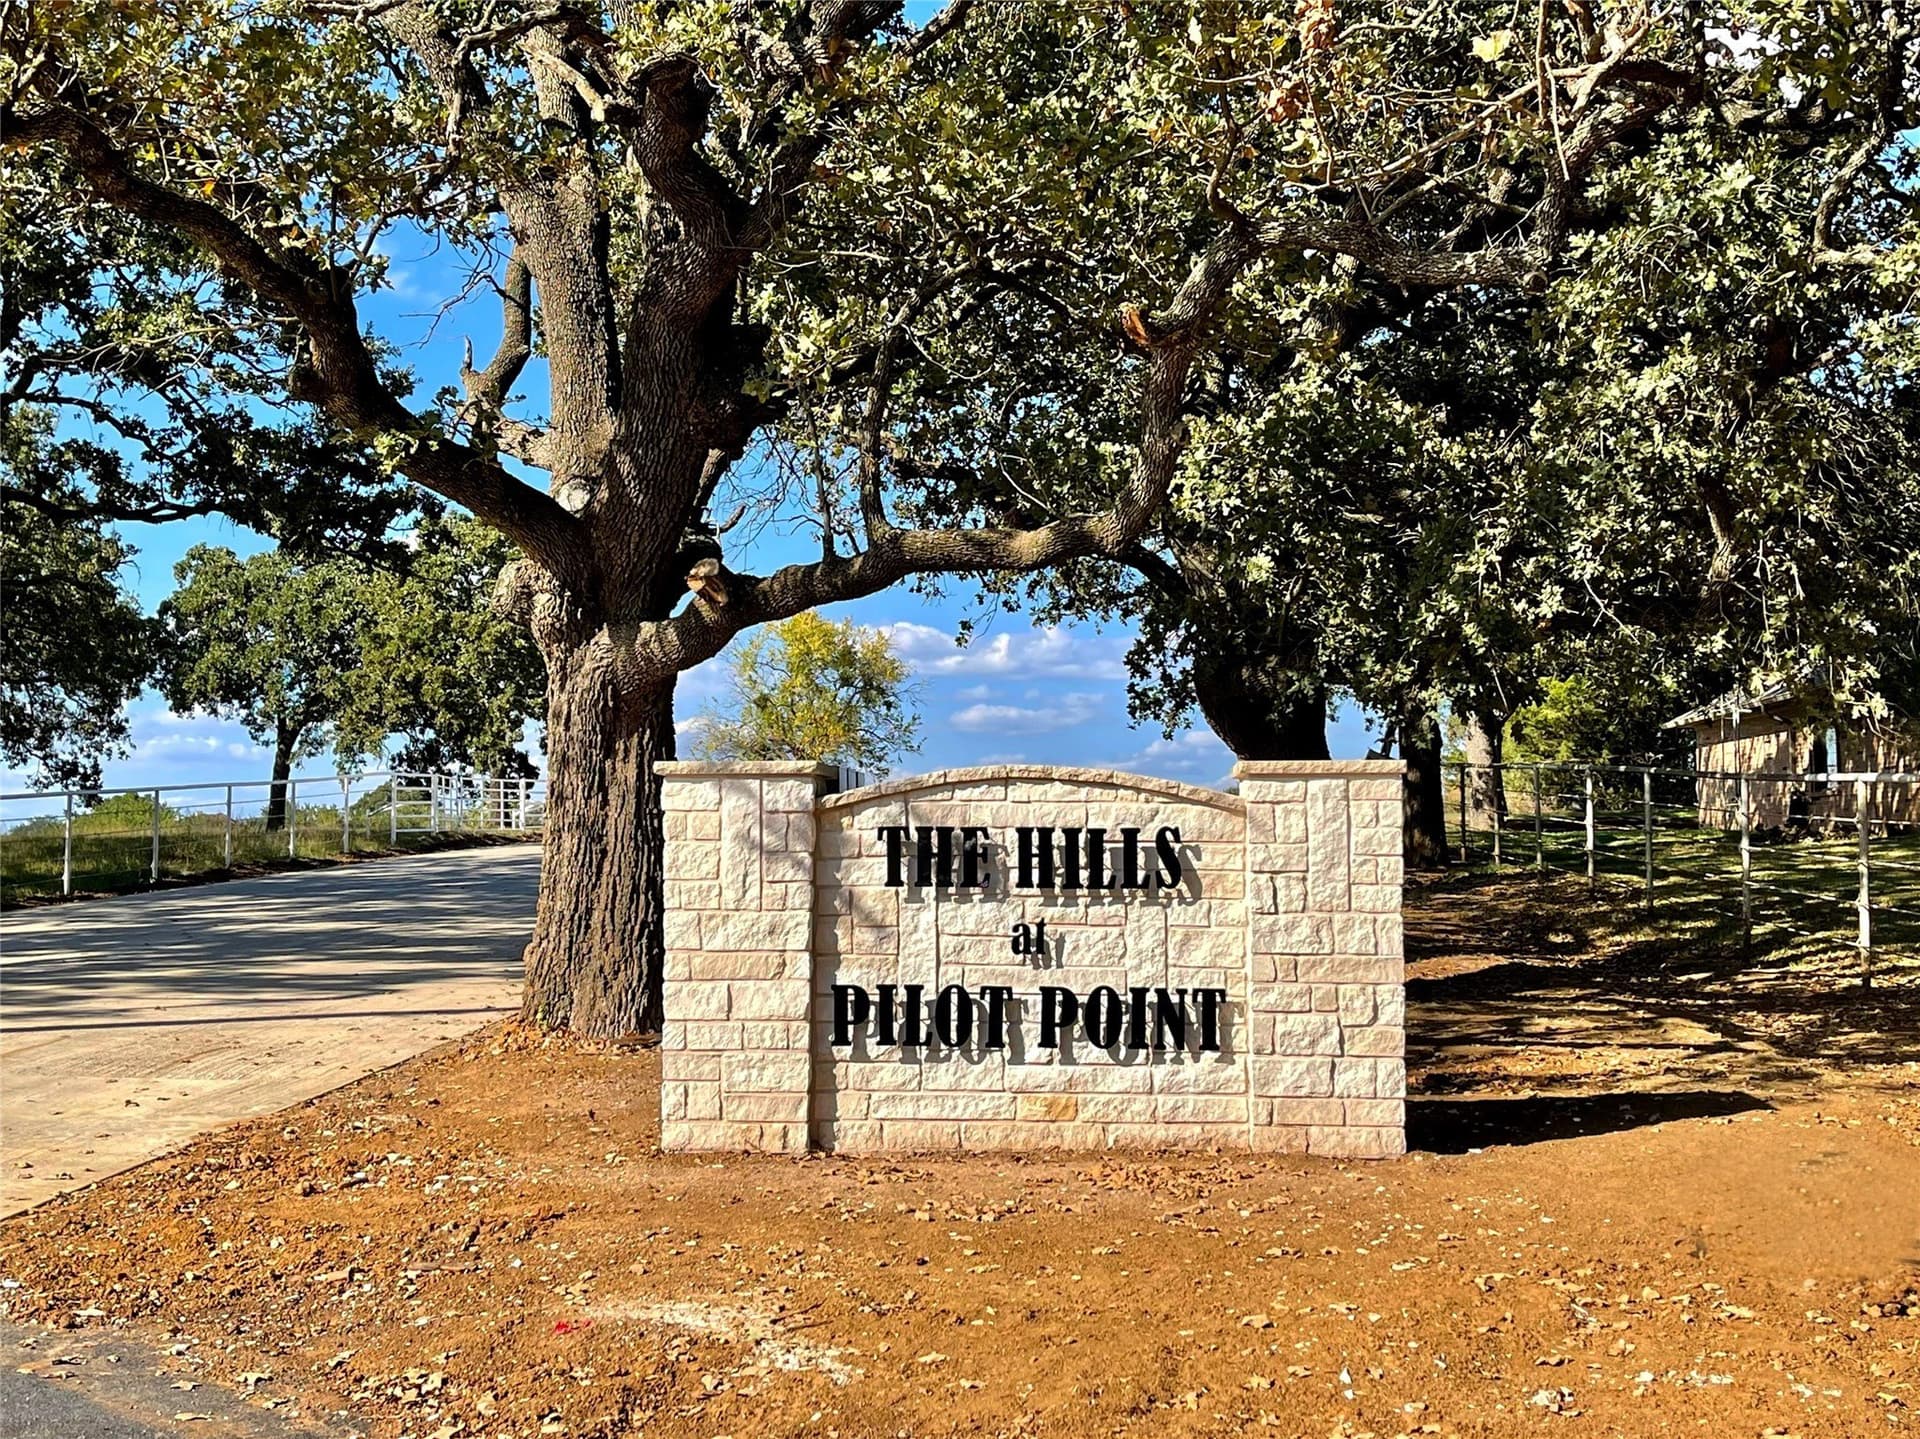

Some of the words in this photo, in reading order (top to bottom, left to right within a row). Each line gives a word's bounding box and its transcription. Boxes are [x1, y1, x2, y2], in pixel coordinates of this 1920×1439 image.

[877, 826, 989, 888] THE
[1015, 826, 1182, 890] HILLS
[1011, 917, 1047, 955] at
[830, 984, 1014, 1048] PILOT
[1037, 985, 1227, 1051] POINT
